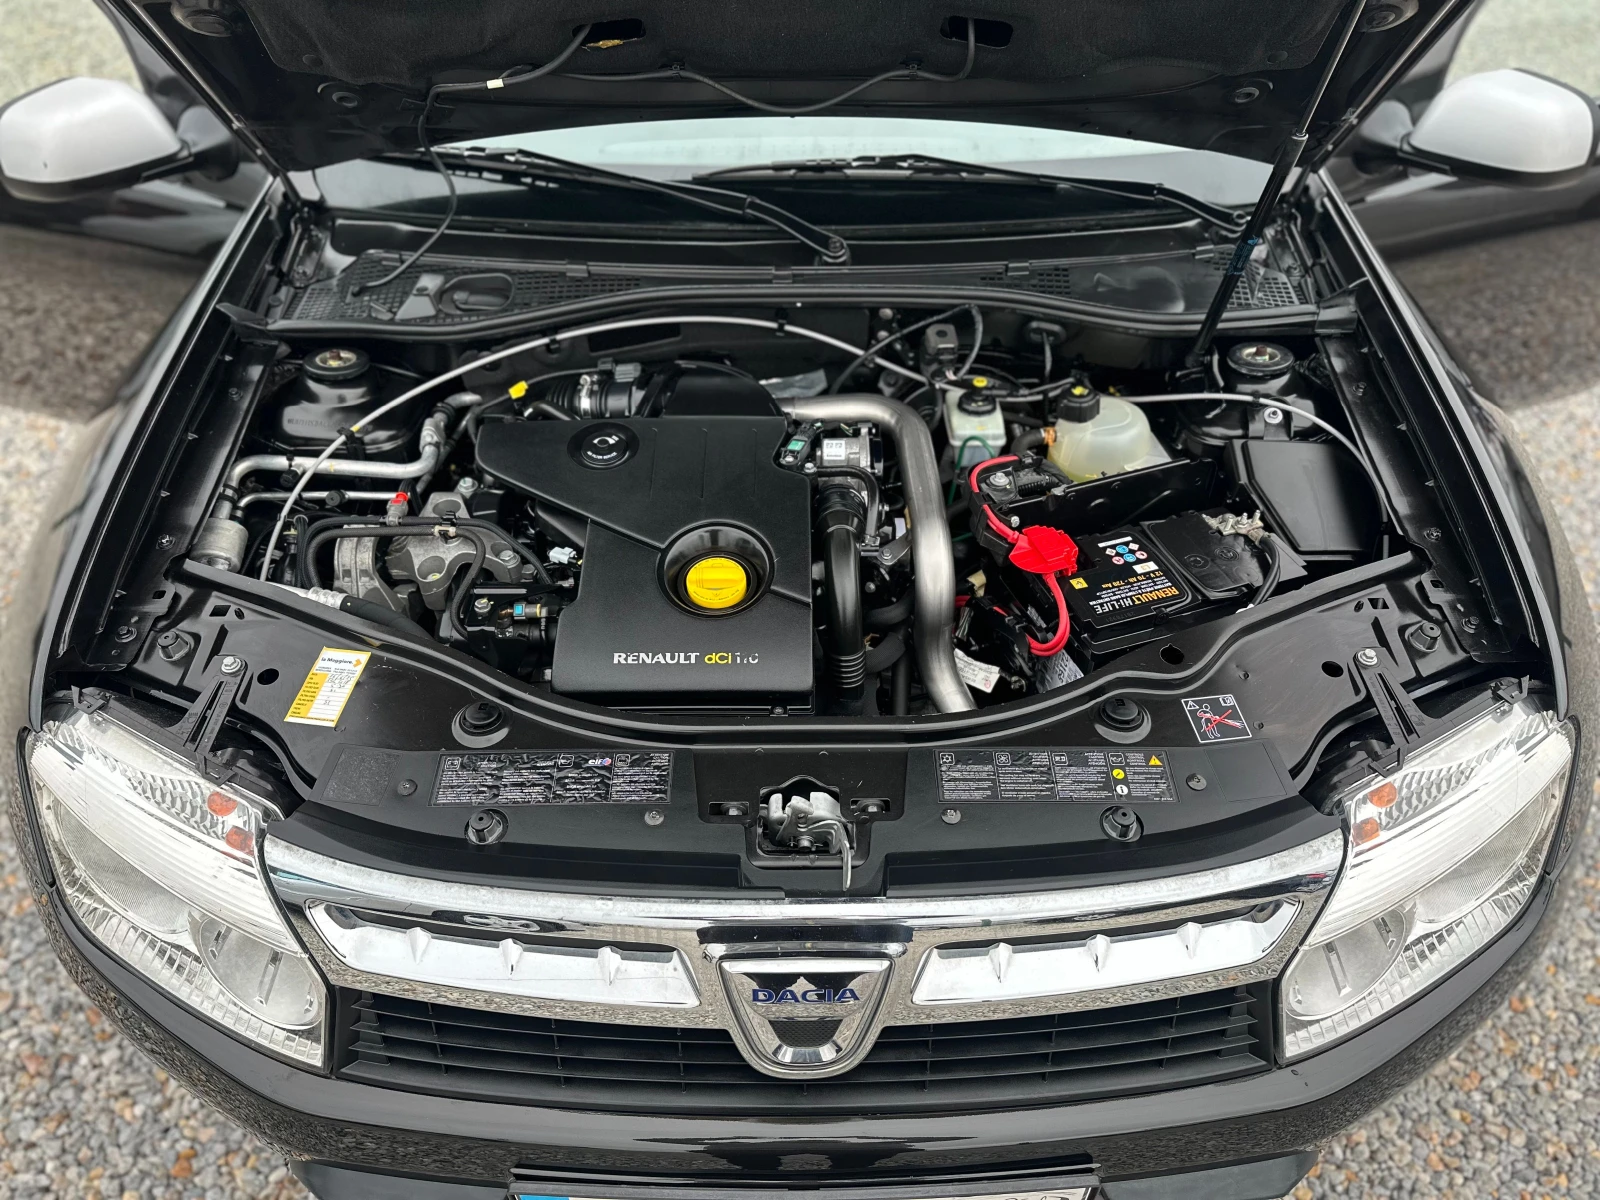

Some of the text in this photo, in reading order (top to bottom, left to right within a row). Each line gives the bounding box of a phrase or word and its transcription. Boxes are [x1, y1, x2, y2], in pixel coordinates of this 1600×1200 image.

[1132, 586, 1180, 605] RENAULT
[613, 652, 700, 664] RENAULT
[704, 652, 732, 664] dCi
[751, 988, 860, 1004] DACIA
